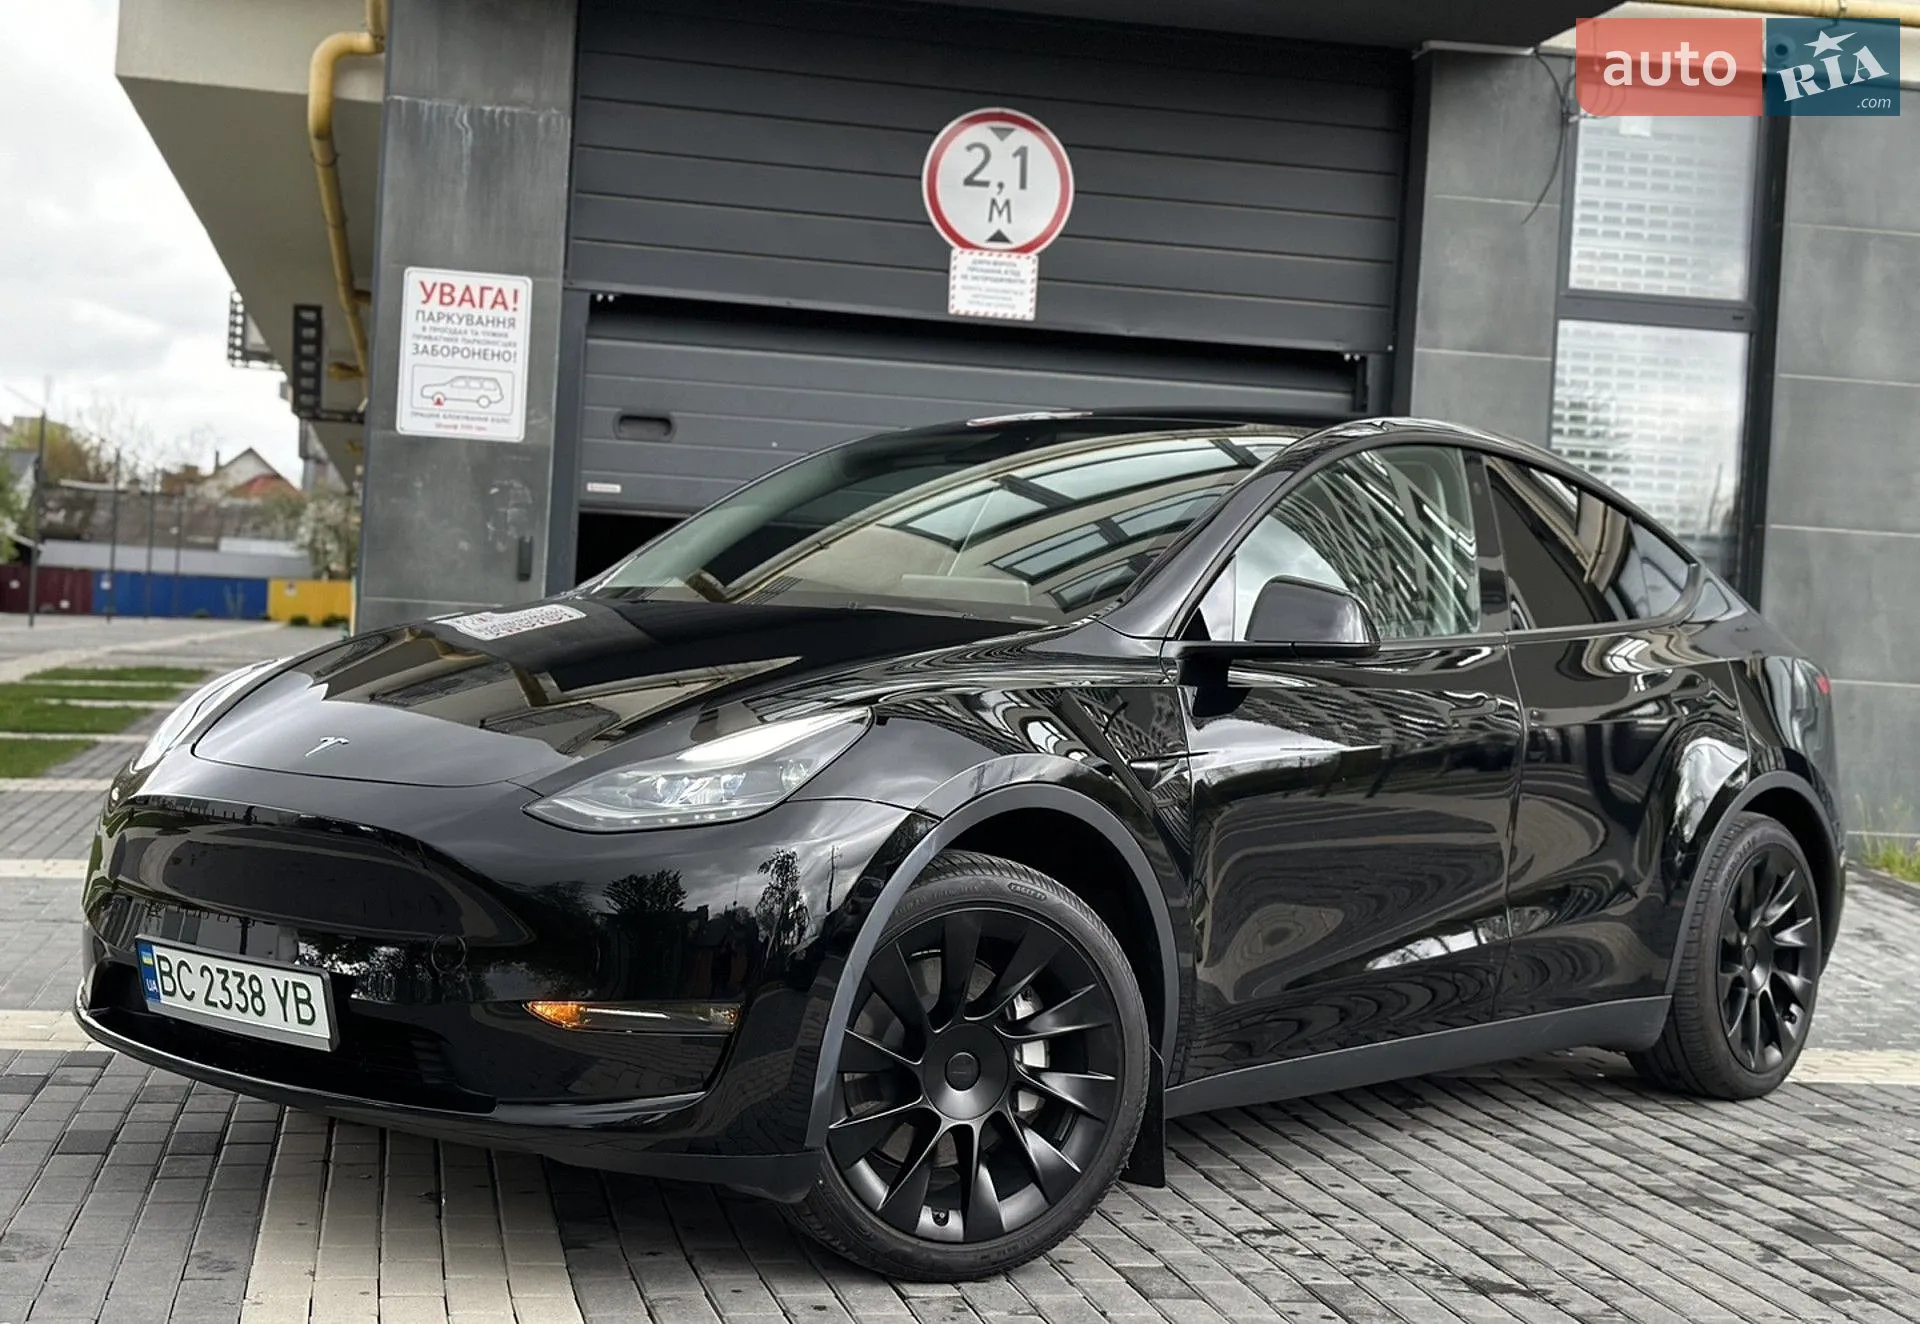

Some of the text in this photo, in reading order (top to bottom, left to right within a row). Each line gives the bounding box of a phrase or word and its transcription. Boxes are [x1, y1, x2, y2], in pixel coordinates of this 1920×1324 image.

[962, 141, 1028, 195] 2,1
[419, 280, 520, 312] УВАГА!
[415, 309, 517, 330] ПАРКУВАННЯ
[412, 343, 517, 363] ЗАБОРОНЕНО!
[146, 977, 158, 993] UA
[156, 953, 316, 1026] BC 2338 YB
